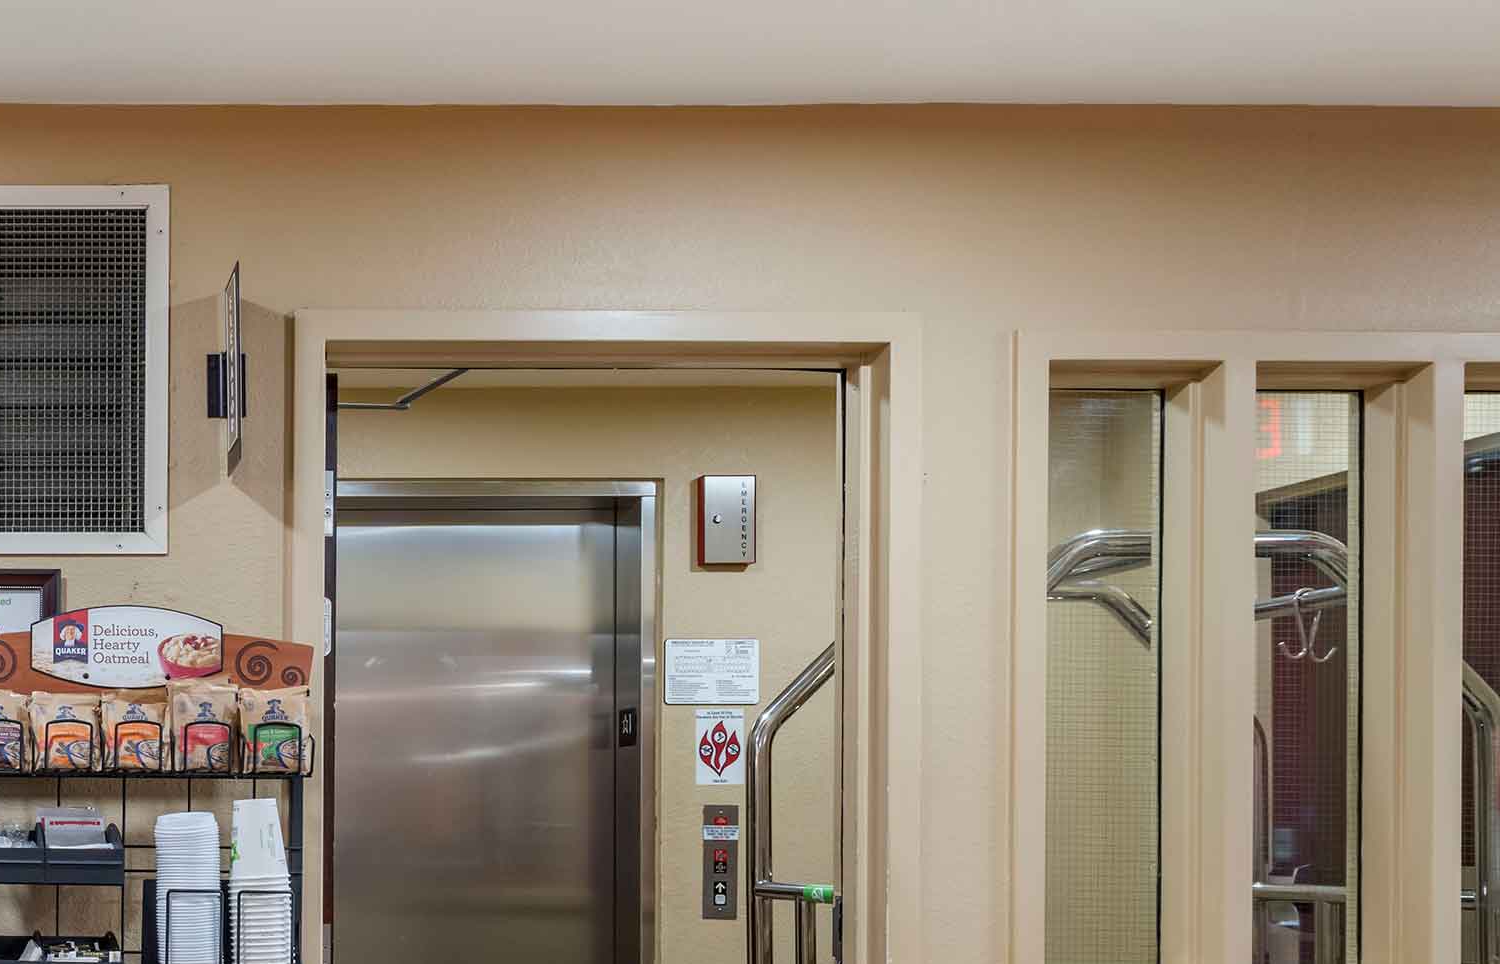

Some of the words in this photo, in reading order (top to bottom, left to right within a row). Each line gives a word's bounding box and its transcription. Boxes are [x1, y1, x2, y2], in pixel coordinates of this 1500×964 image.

[92, 624, 159, 638] Delicious,
[55, 647, 87, 657] QUAKER
[92, 639, 141, 653] Hearty
[92, 652, 150, 664] Oatmeal
